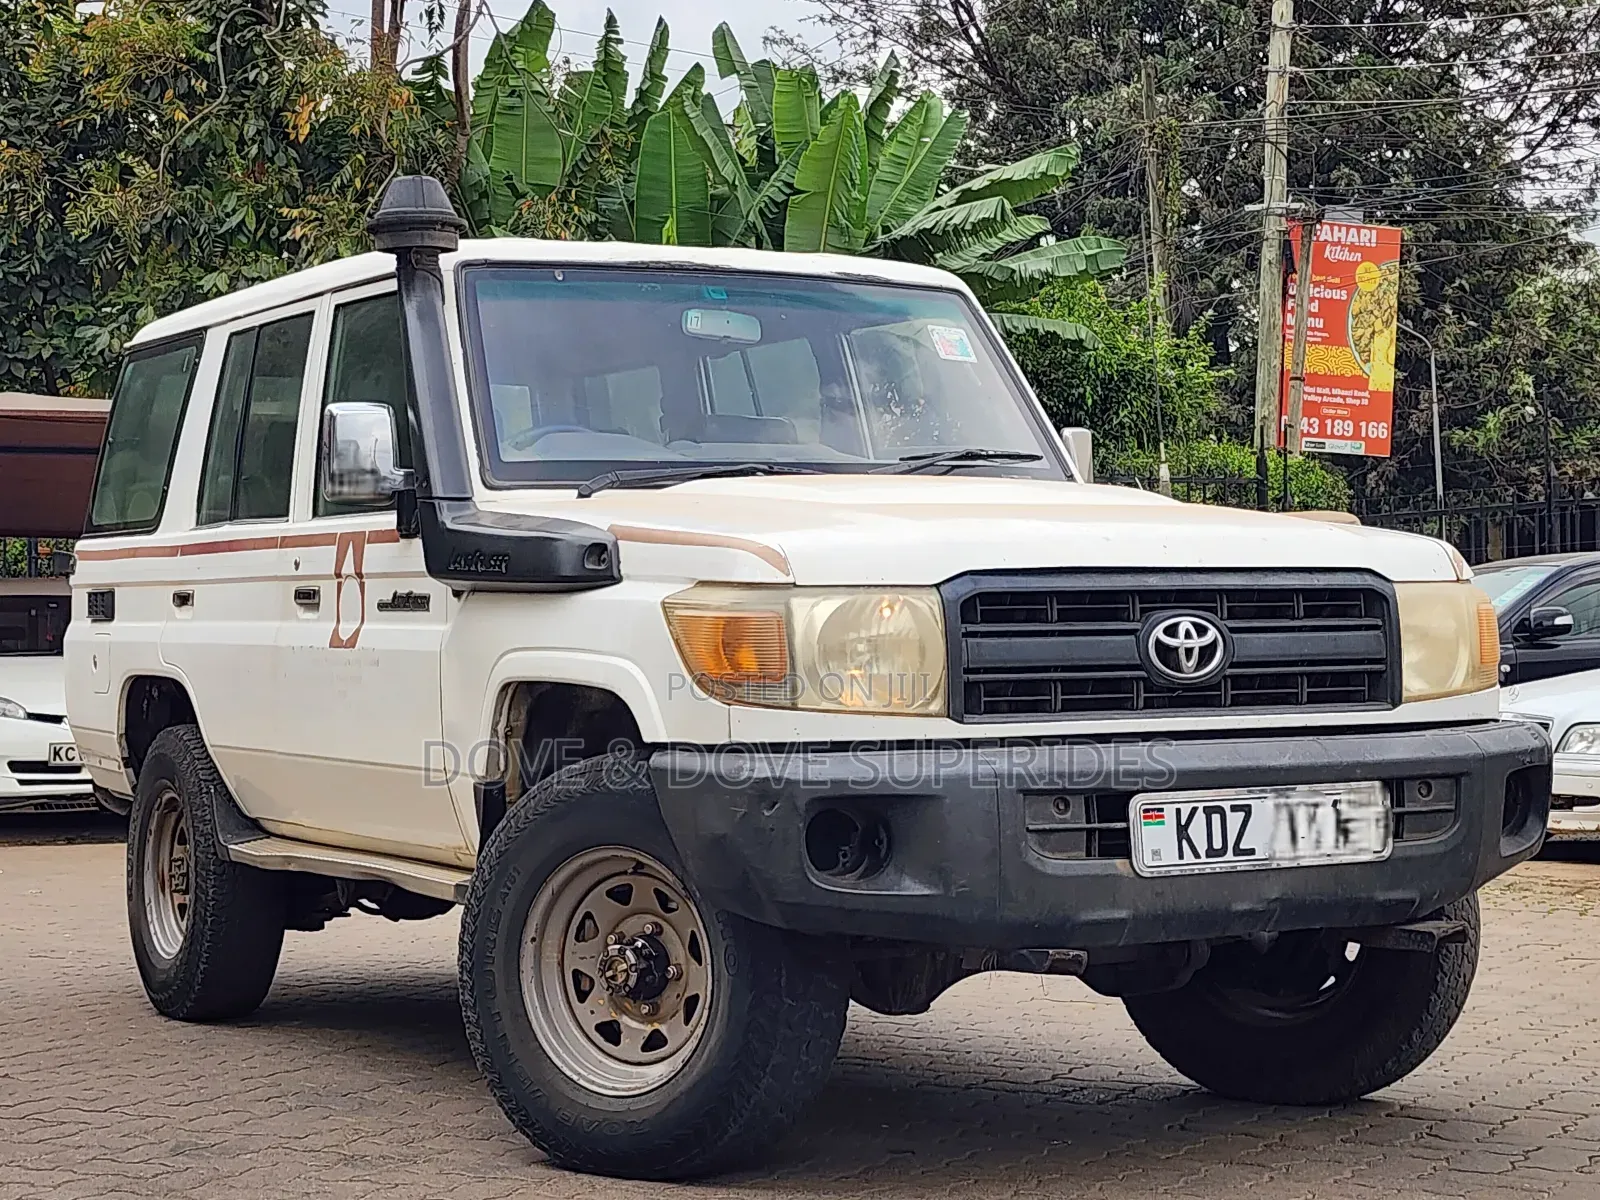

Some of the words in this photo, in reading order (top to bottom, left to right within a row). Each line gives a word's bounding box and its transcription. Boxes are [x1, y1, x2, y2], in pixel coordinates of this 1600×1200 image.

[1324, 244, 1362, 262] Kitchen
[1288, 283, 1348, 300] Dicious
[1287, 313, 1323, 328] Mnu
[1325, 418, 1354, 437] 189
[1359, 421, 1388, 439] 166
[52, 746, 84, 762] KC
[1175, 803, 1257, 861] KDZ
